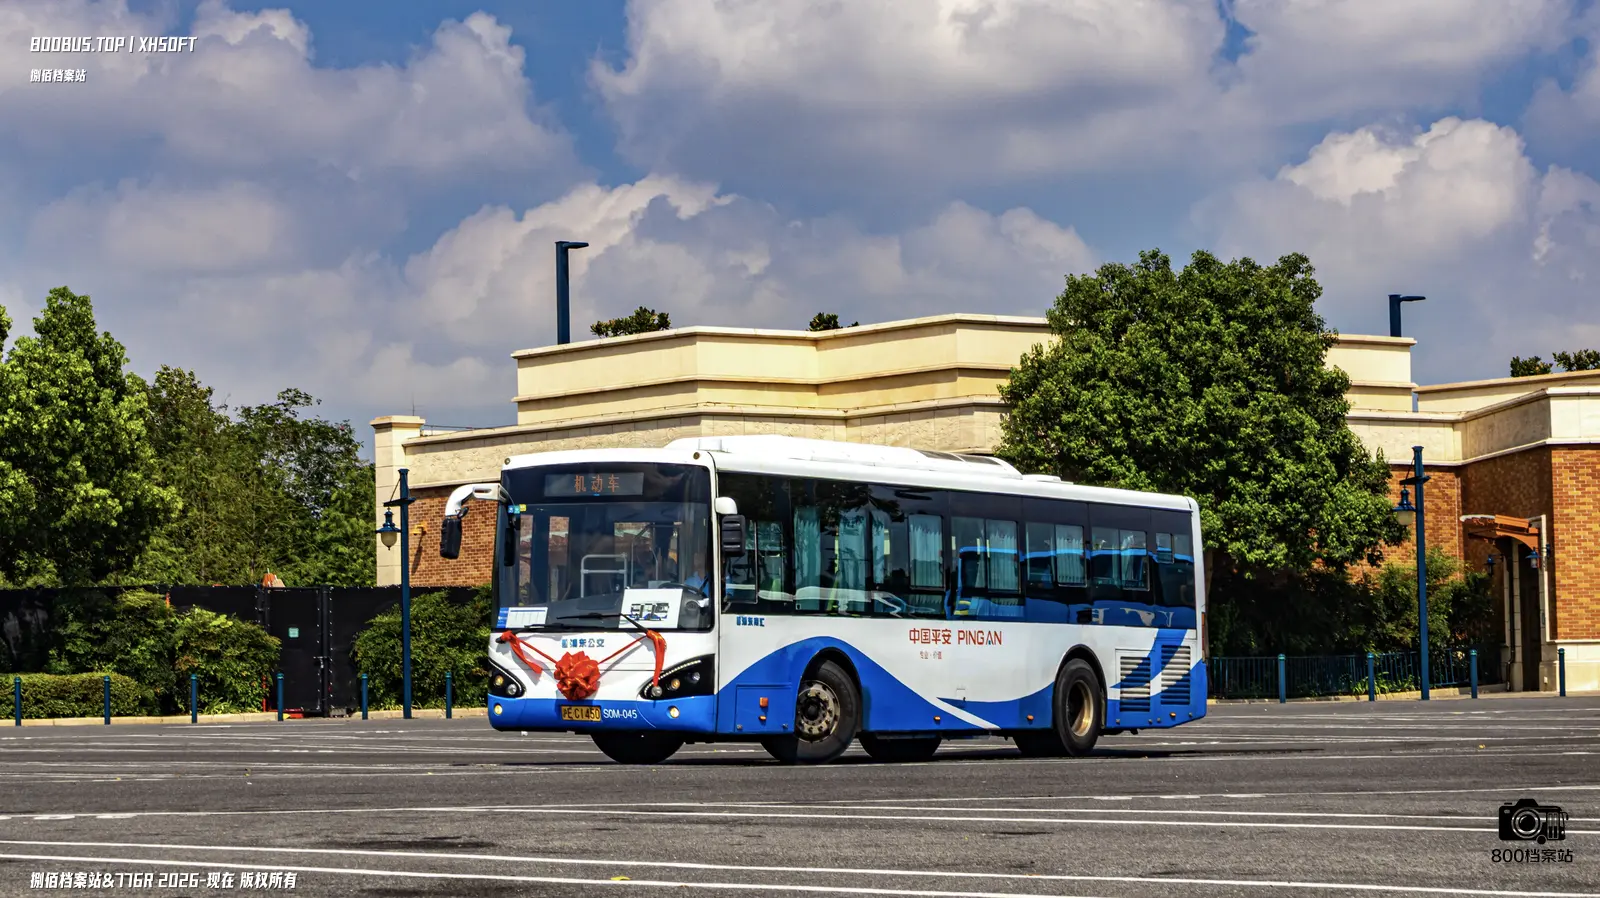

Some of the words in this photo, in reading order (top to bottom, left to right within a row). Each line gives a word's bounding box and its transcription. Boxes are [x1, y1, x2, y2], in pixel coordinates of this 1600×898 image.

[574, 473, 620, 493] 机动车
[909, 628, 952, 645] 中国平安
